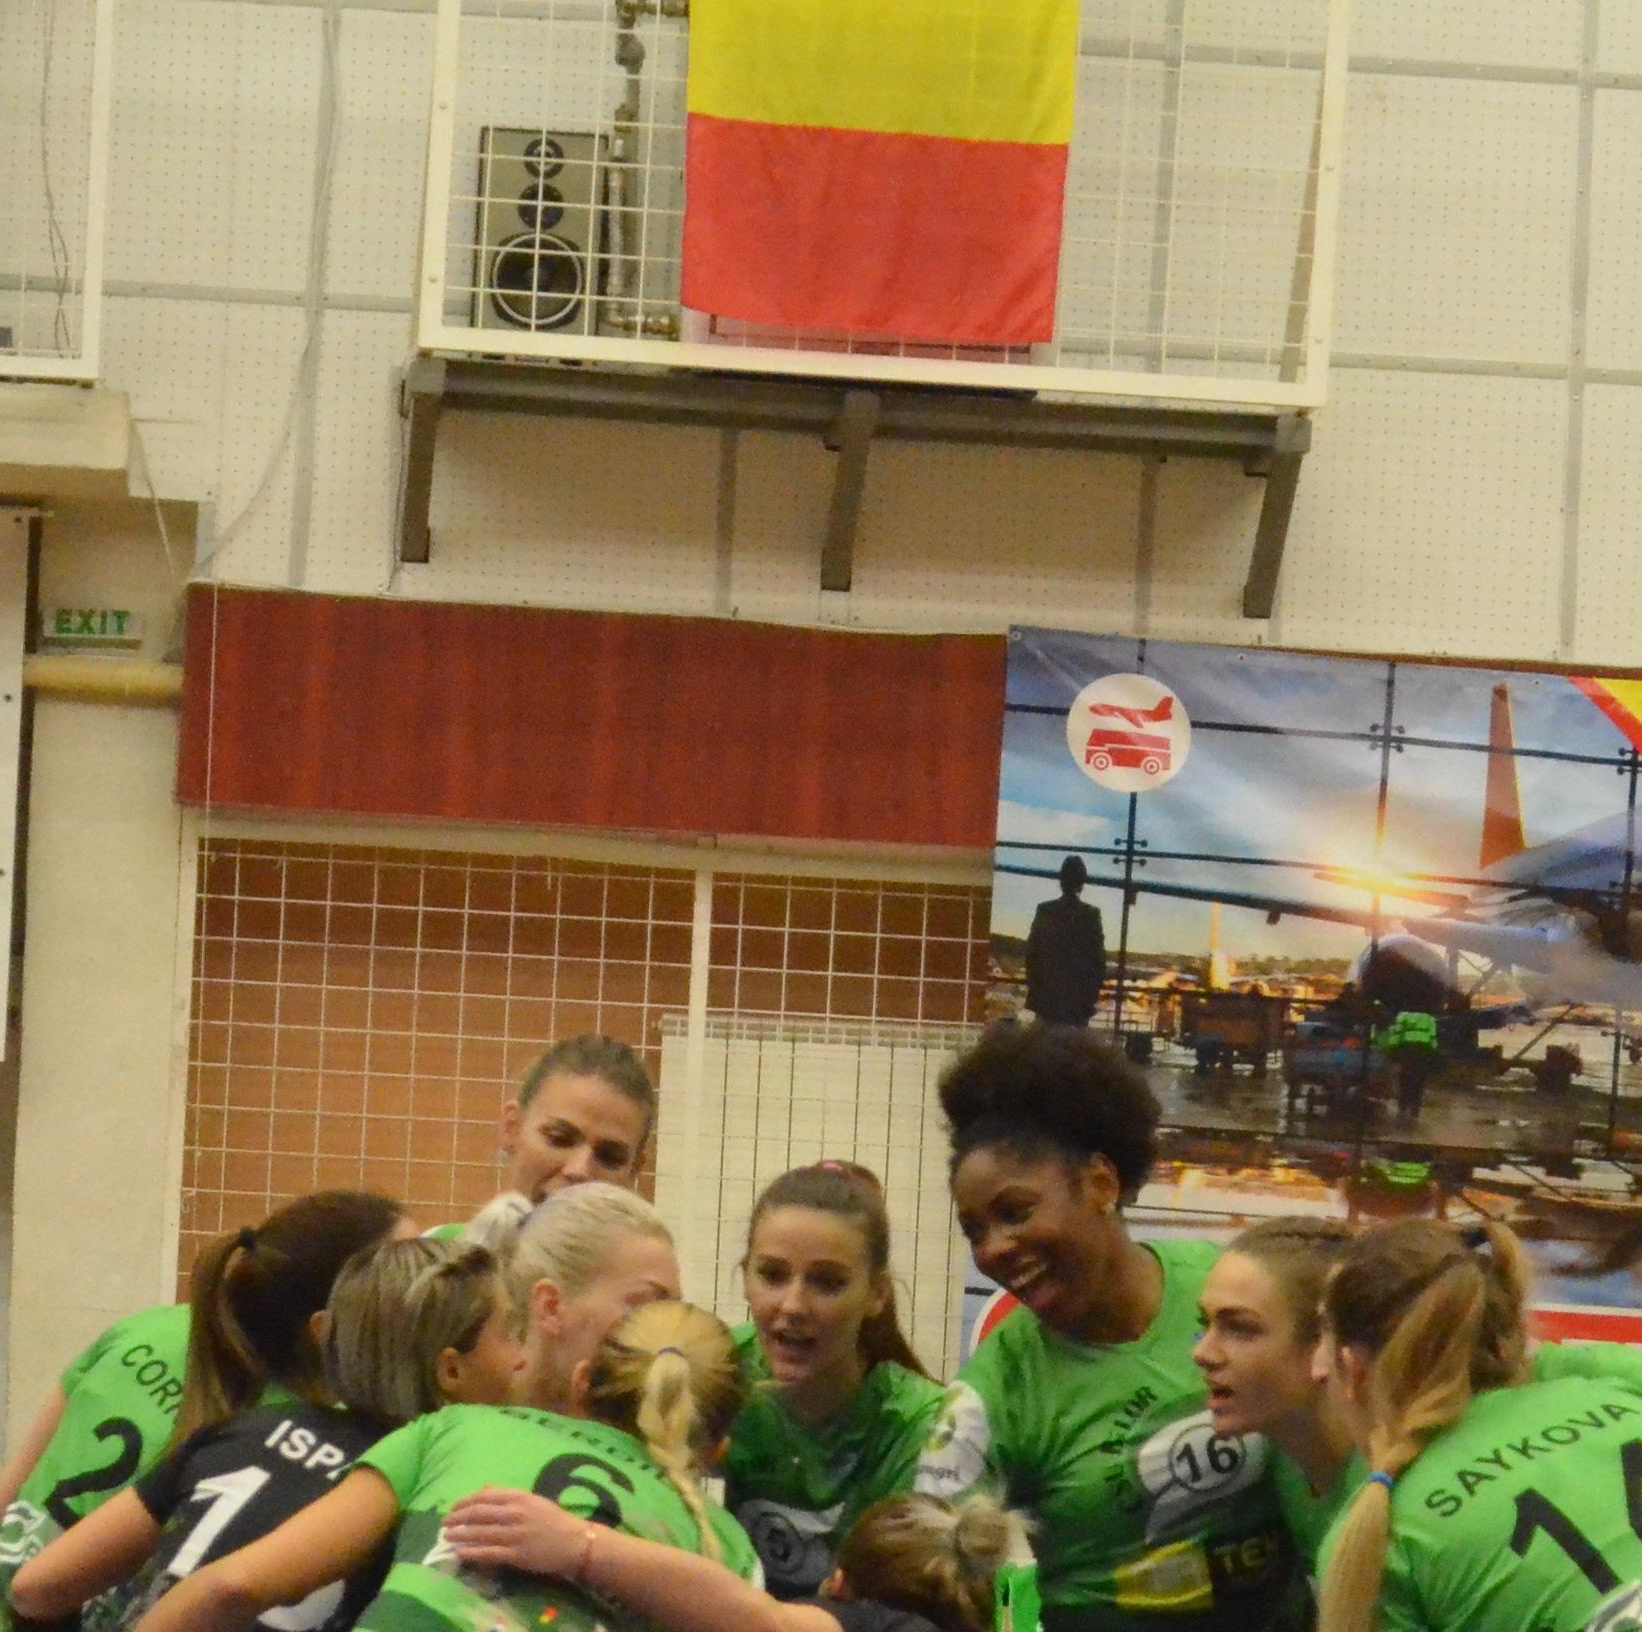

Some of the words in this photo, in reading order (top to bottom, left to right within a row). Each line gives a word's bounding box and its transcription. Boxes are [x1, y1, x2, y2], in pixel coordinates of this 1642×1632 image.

[55, 608, 130, 635] EXIT
[121, 1344, 182, 1415] COR
[43, 1415, 144, 1530] 2
[264, 1419, 352, 1480] ISP
[1176, 1435, 1239, 1483] 16
[1424, 1403, 1640, 1518] SAYKOVA
[533, 1453, 635, 1529] 6
